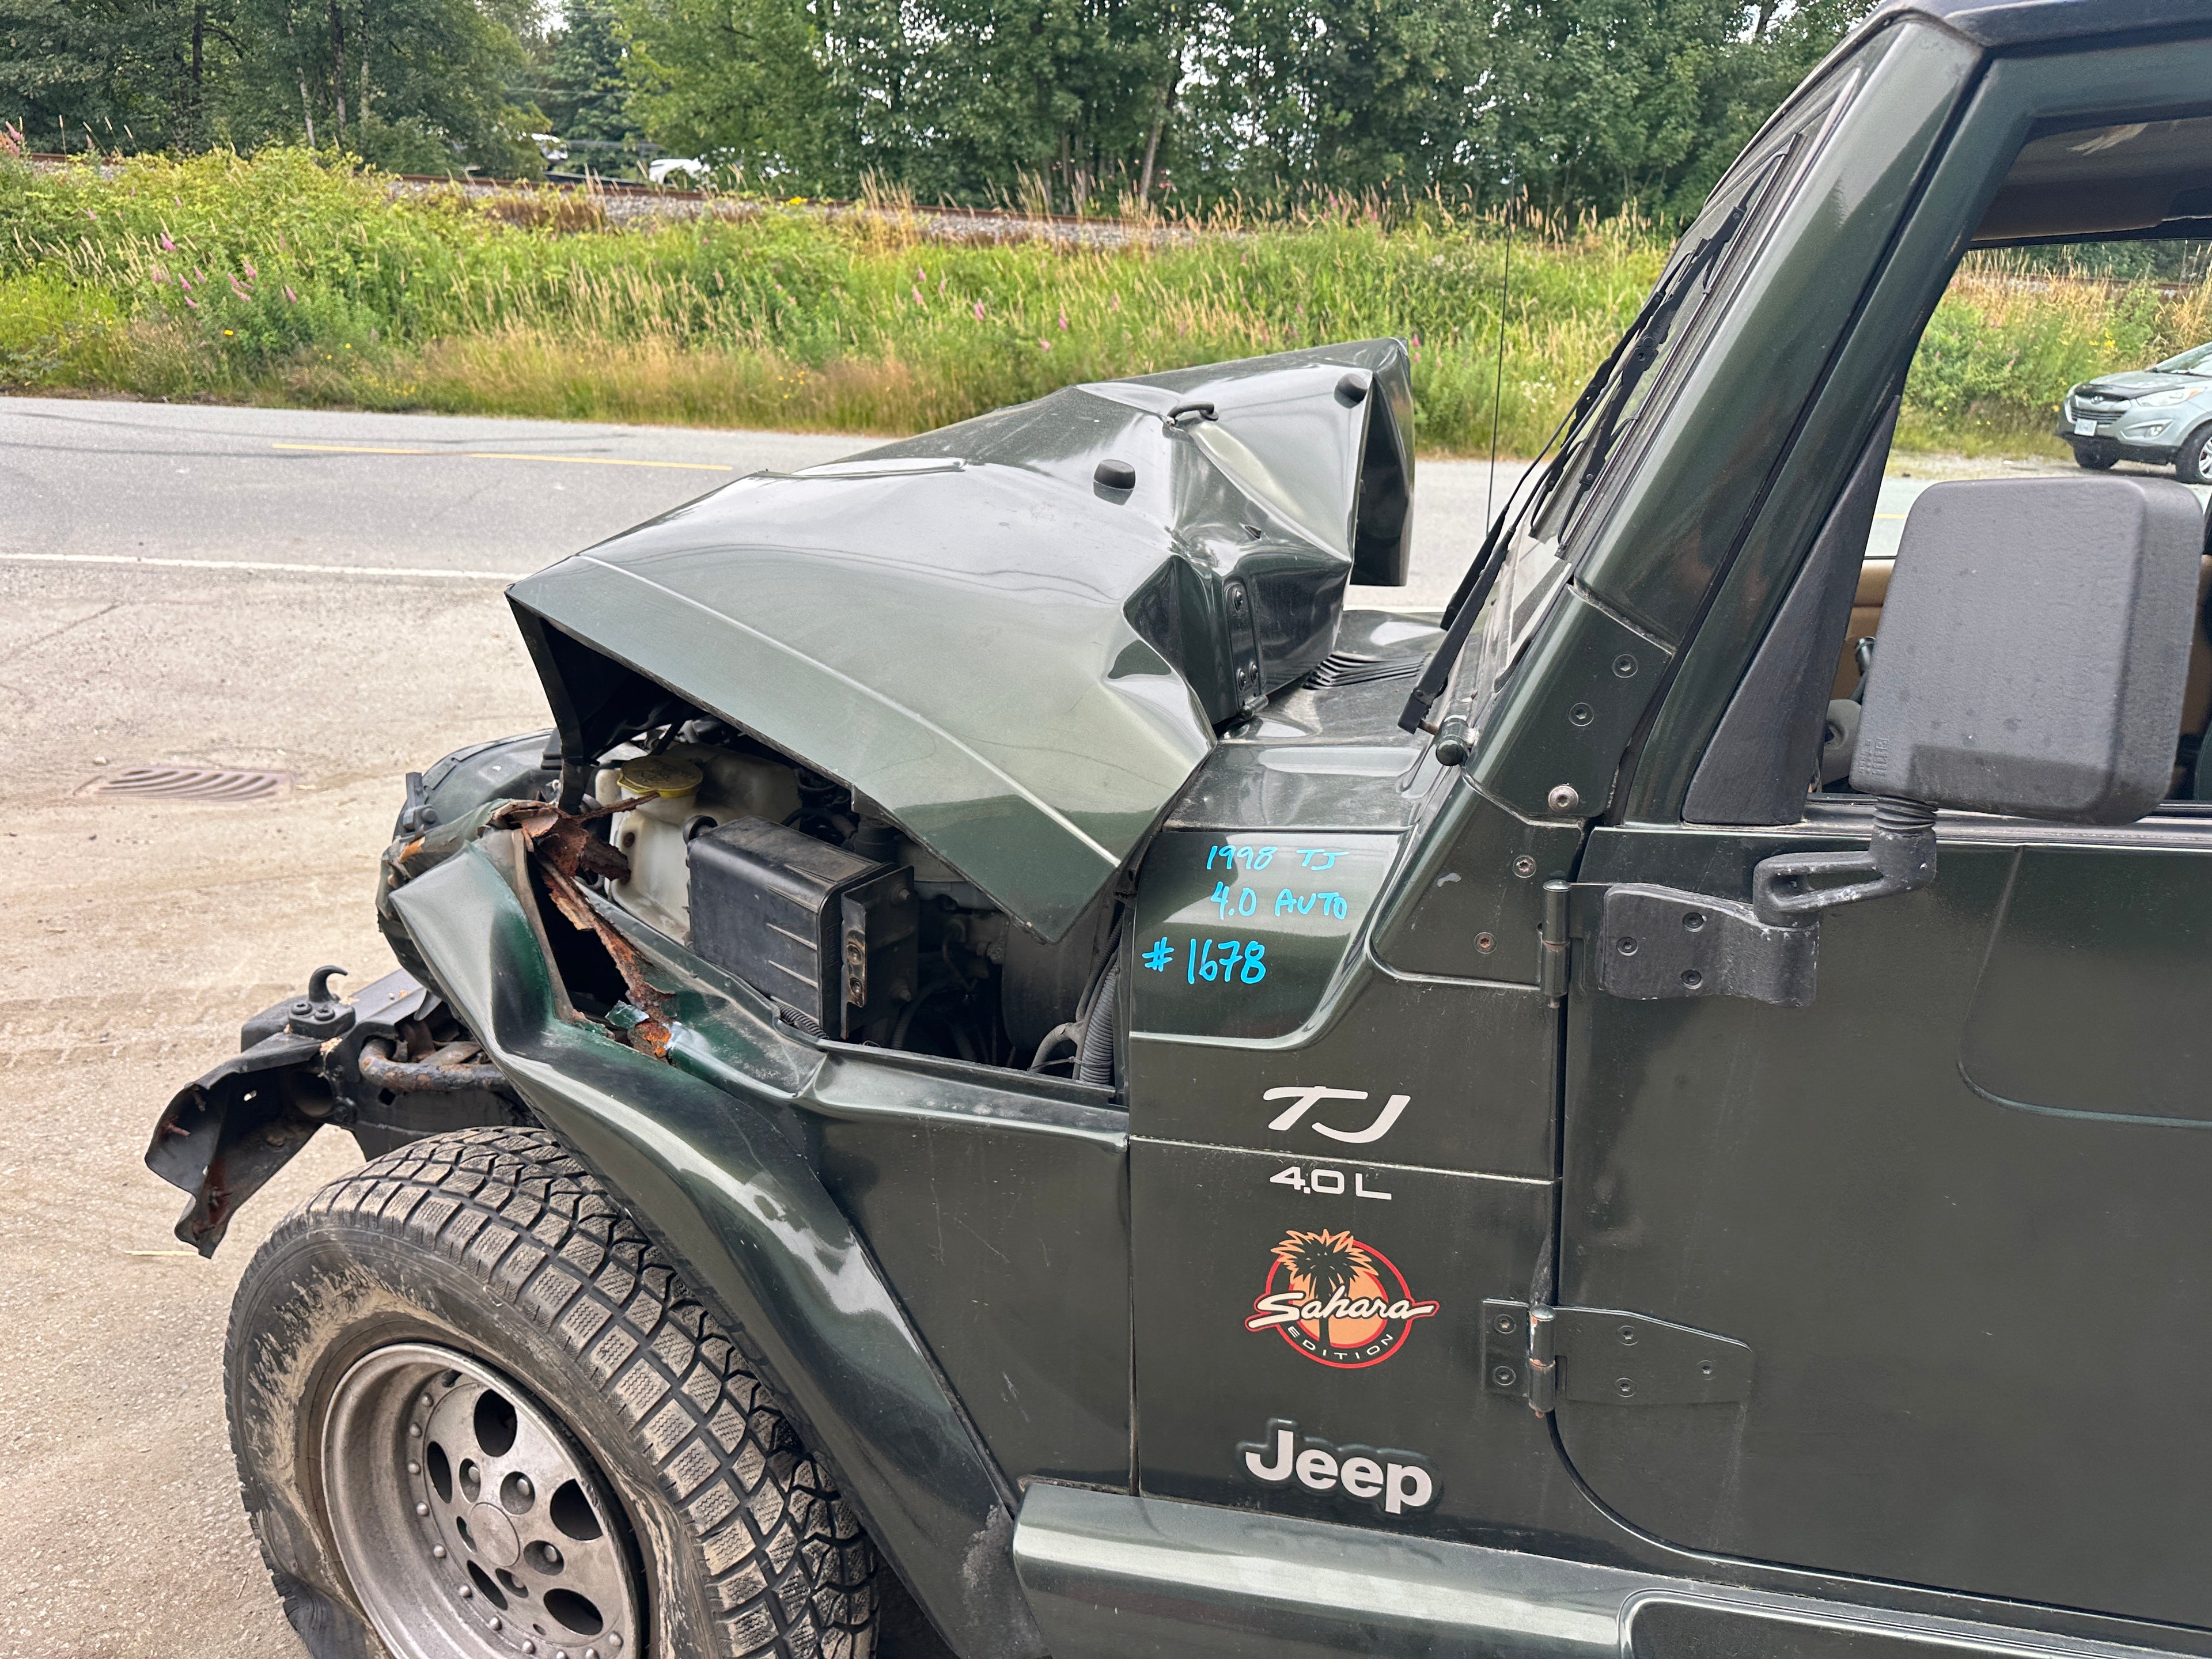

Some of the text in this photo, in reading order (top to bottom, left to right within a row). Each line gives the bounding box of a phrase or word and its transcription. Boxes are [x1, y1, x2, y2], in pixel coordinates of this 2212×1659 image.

[1206, 845, 1350, 870] 1998 TJ
[1210, 881, 1348, 920] 4.0 AUTO
[1263, 1086, 1411, 1143] TJ
[1248, 1285, 1434, 1328] Sahara
[1287, 1326, 1393, 1360] EDITION
[1245, 1429, 1433, 1514] Jeep
